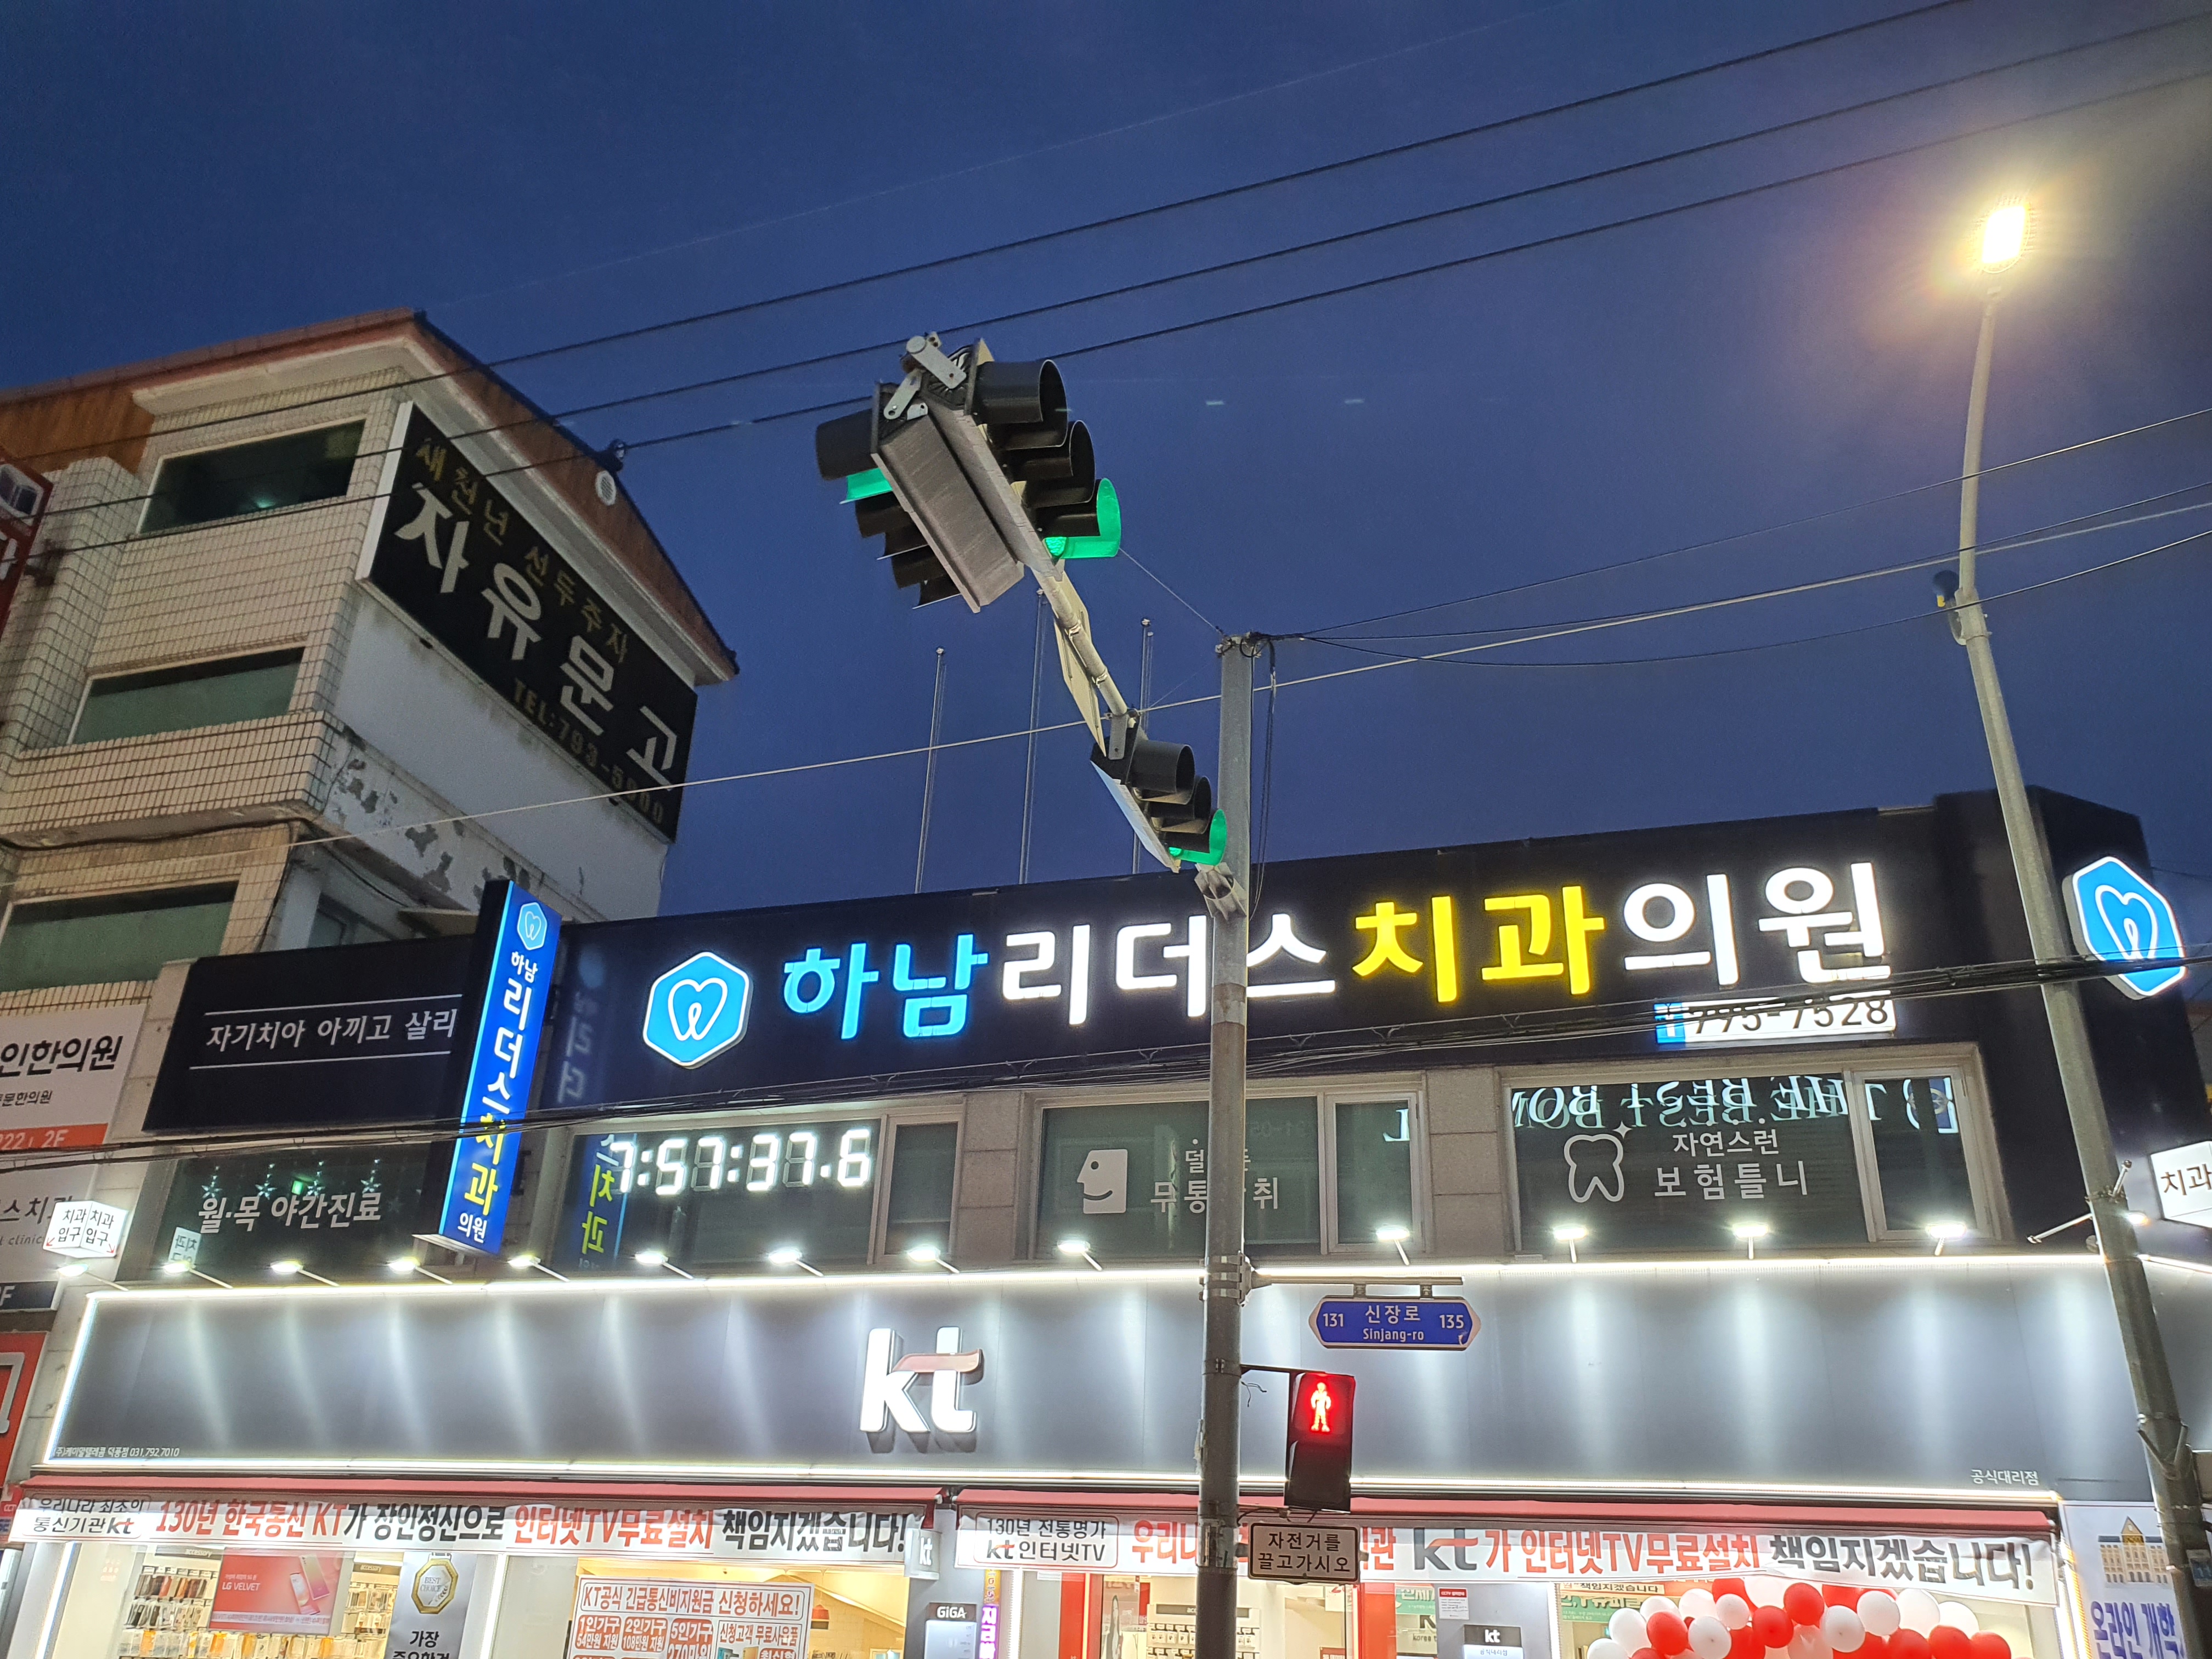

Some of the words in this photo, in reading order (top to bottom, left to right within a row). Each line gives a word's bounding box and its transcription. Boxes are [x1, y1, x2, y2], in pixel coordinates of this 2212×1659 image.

[394, 482, 677, 791] 자유문고
[511, 951, 538, 983] 하남
[206, 1020, 305, 1052] 자기치아
[318, 1015, 390, 1045] 아끼고
[41, 1129, 69, 1148] 2F
[1672, 1127, 1780, 1158] 자연스런
[1655, 1161, 1809, 1201] 보험틀니
[2160, 1163, 2212, 1196] 치과
[1150, 1177, 1278, 1214] 무통취
[62, 1209, 87, 1224] 치과
[89, 1209, 114, 1229] 치과
[271, 1192, 382, 1229] 야간진료
[58, 1227, 81, 1243] 입구
[86, 1228, 109, 1247] 입구
[457, 1212, 487, 1244] 의원
[1322, 1313, 1344, 1328] 131
[1364, 1305, 1421, 1325] 신장로
[1439, 1314, 1465, 1329] 135
[1362, 1328, 1425, 1342] Sinjang-ro
[860, 1326, 984, 1434] kt
[1970, 1469, 2039, 1486] 공식대리점
[155, 1499, 217, 1537] 130년
[224, 1499, 308, 1538] 한국통신
[312, 1502, 367, 1539] KT가
[373, 1503, 505, 1543] 장인정신으로
[515, 1505, 713, 1550] 인터넷TV무료설치
[722, 1508, 907, 1553] 책임지겠습니다!
[986, 1517, 1031, 1536] 130년
[1037, 1519, 1107, 1540] 전통명가
[919, 1537, 933, 1566] kt
[1268, 1531, 1341, 1552] 자전거를
[1257, 1551, 1351, 1573] 끌고가시오
[1521, 1528, 1760, 1575] 인터넷TV무료설치
[1770, 1534, 2034, 1591] 책임지겠습니다!
[222, 1582, 233, 1590] LG
[234, 1582, 261, 1591] VELVET
[420, 1584, 443, 1592] CHOICE
[583, 1586, 623, 1611] KT공식
[718, 1590, 800, 1618] 신청하세요!
[936, 1606, 967, 1619] GiGA
[579, 1616, 621, 1633] 1인가구
[625, 1618, 667, 1636] 2인가구
[670, 1622, 713, 1643] 5인가구
[409, 1630, 440, 1649] 가장
[1485, 1629, 1501, 1643] kt
